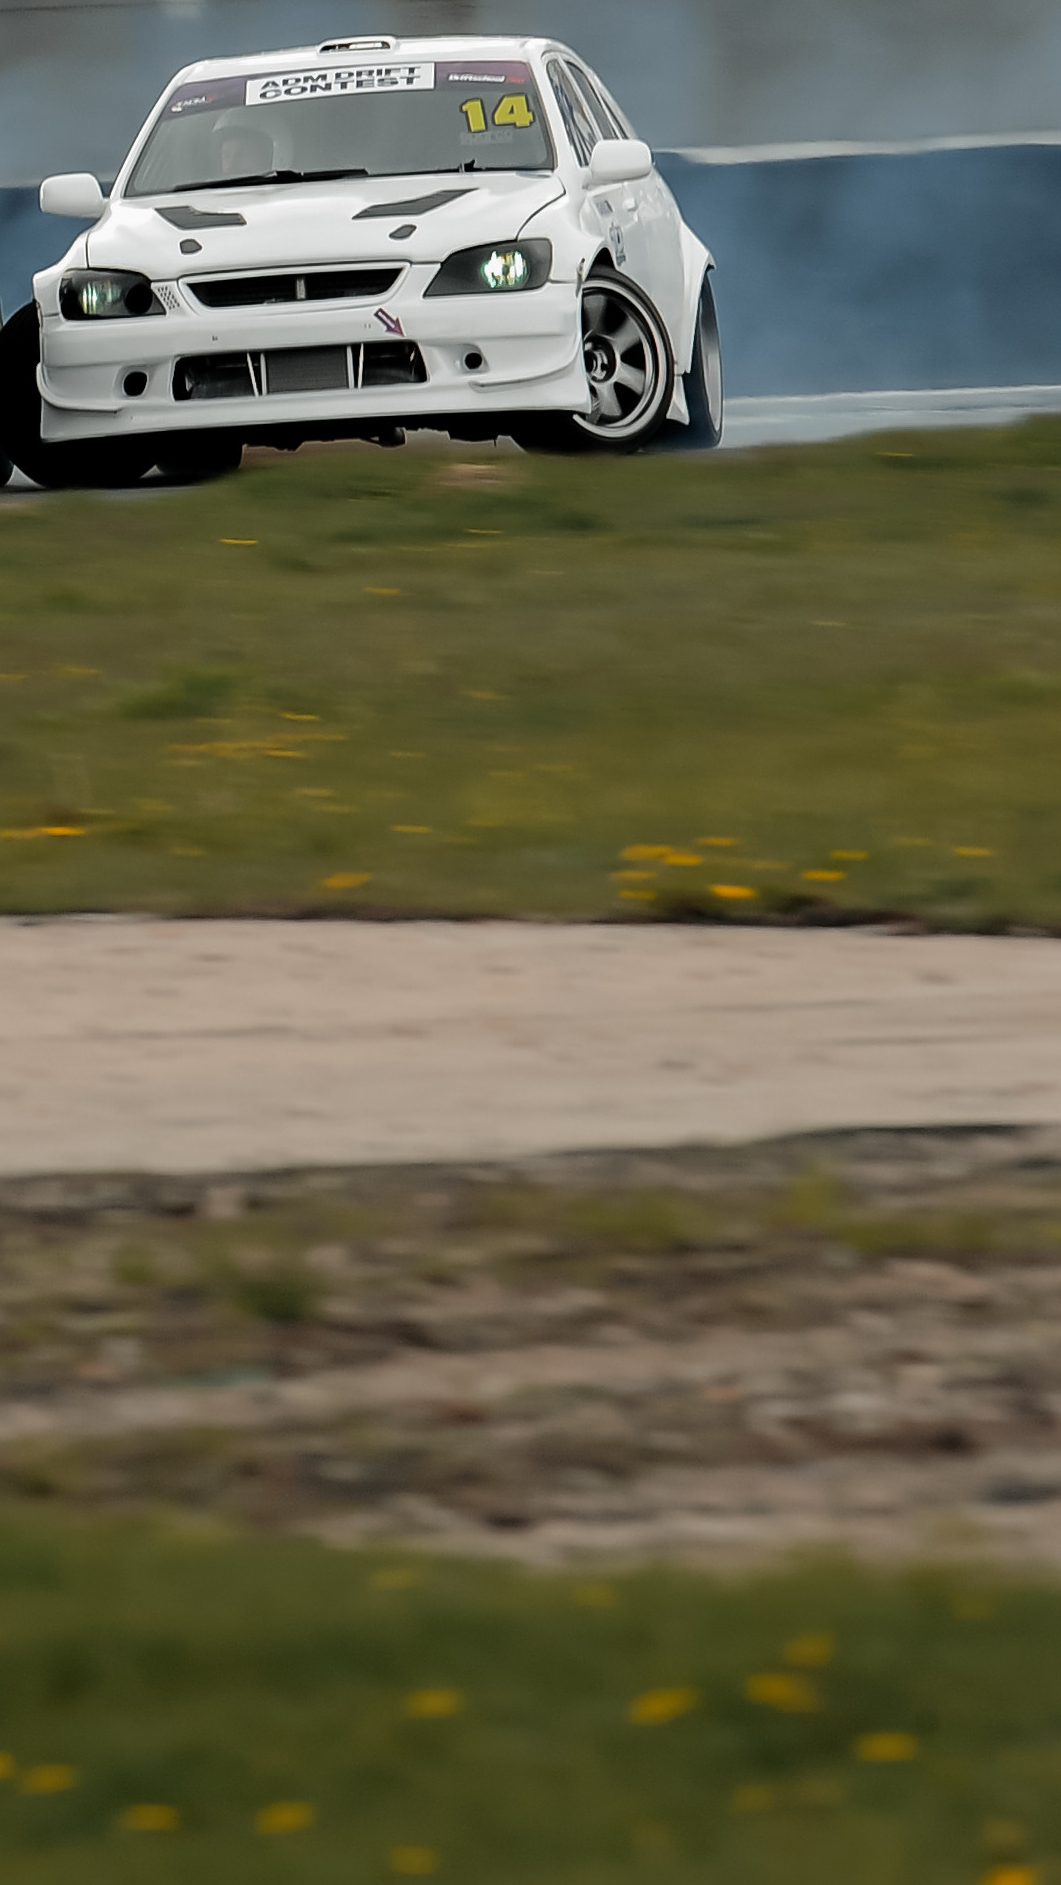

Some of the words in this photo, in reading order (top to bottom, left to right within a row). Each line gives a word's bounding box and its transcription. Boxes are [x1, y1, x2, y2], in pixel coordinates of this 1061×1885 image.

[259, 75, 421, 100] CONTEST
[261, 74, 327, 90] ADM
[334, 66, 422, 81] DRIFT
[460, 93, 536, 133] 14
